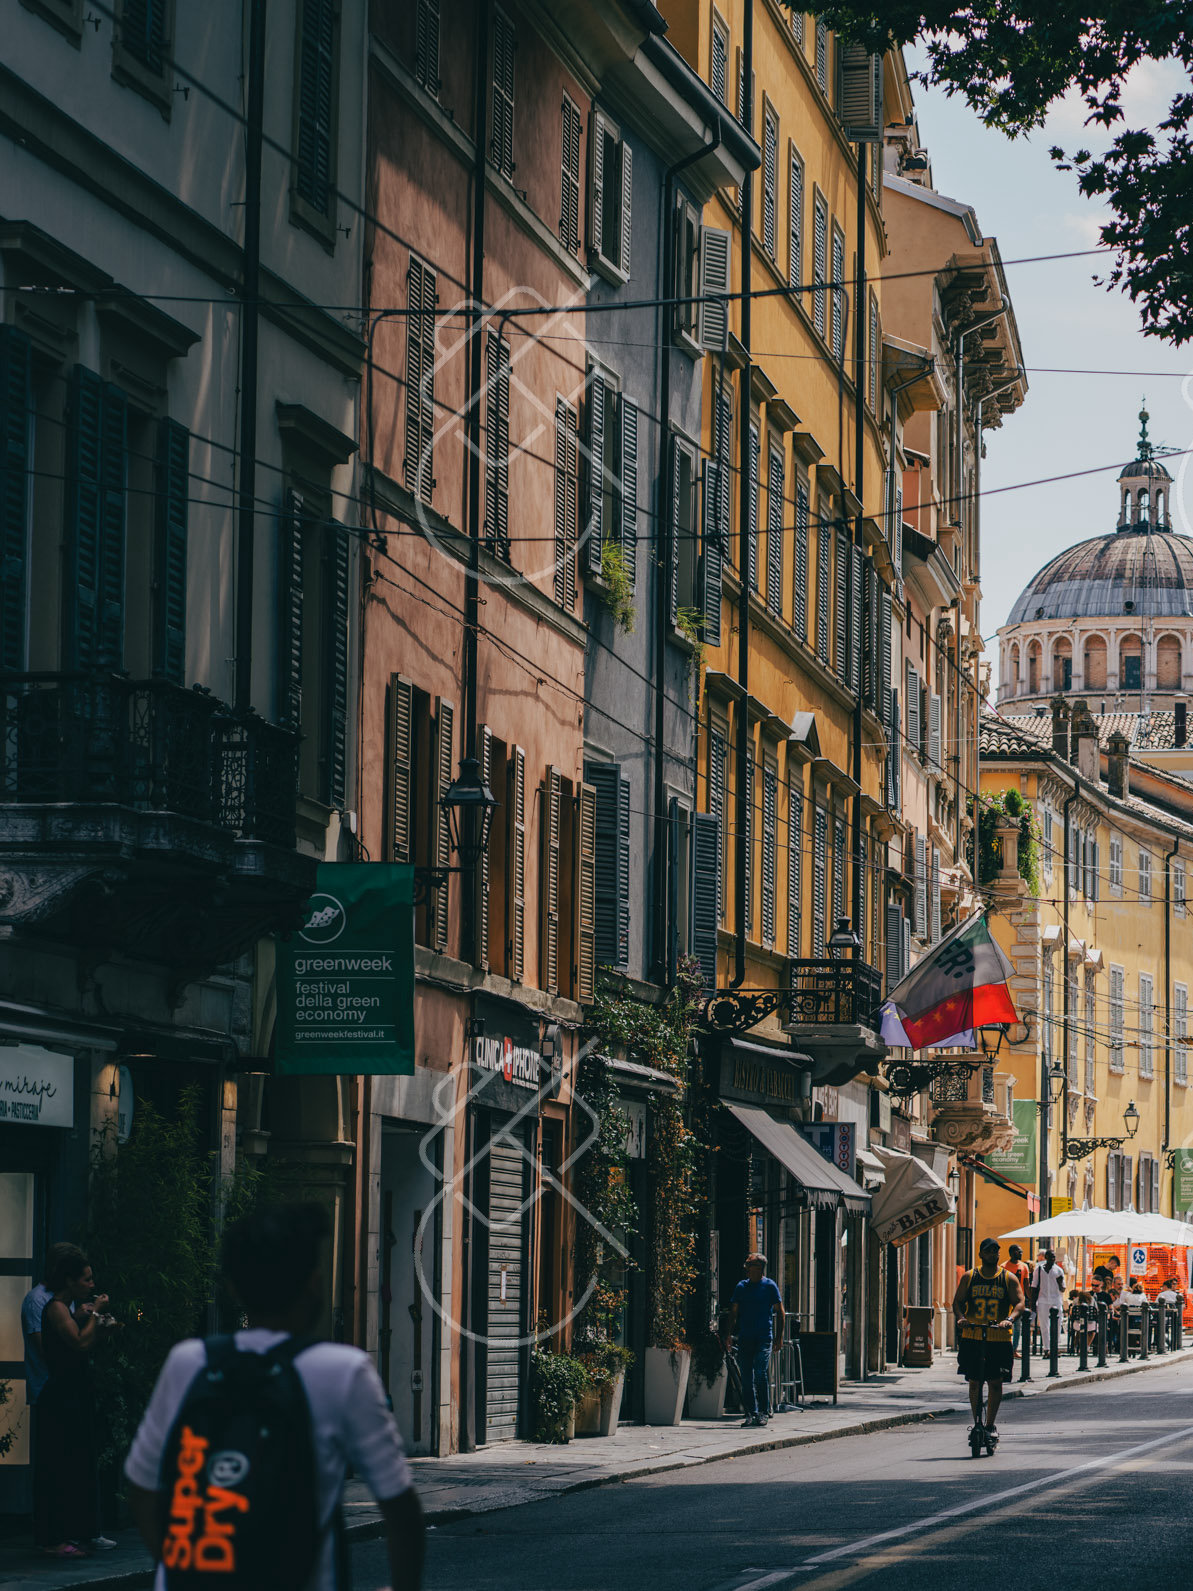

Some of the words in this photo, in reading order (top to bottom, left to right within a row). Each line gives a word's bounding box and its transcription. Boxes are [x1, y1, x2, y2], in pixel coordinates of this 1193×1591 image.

[294, 955, 393, 975] greenweek
[295, 981, 350, 994] festival
[295, 994, 333, 1007] della
[337, 996, 380, 1010] green
[295, 1010, 367, 1023] economy
[295, 1030, 385, 1040] greenweekfestival.it
[475, 1036, 505, 1073] CLINICA
[896, 1199, 944, 1233] BAR
[975, 1299, 1000, 1321] 33
[163, 1425, 209, 1571] Super
